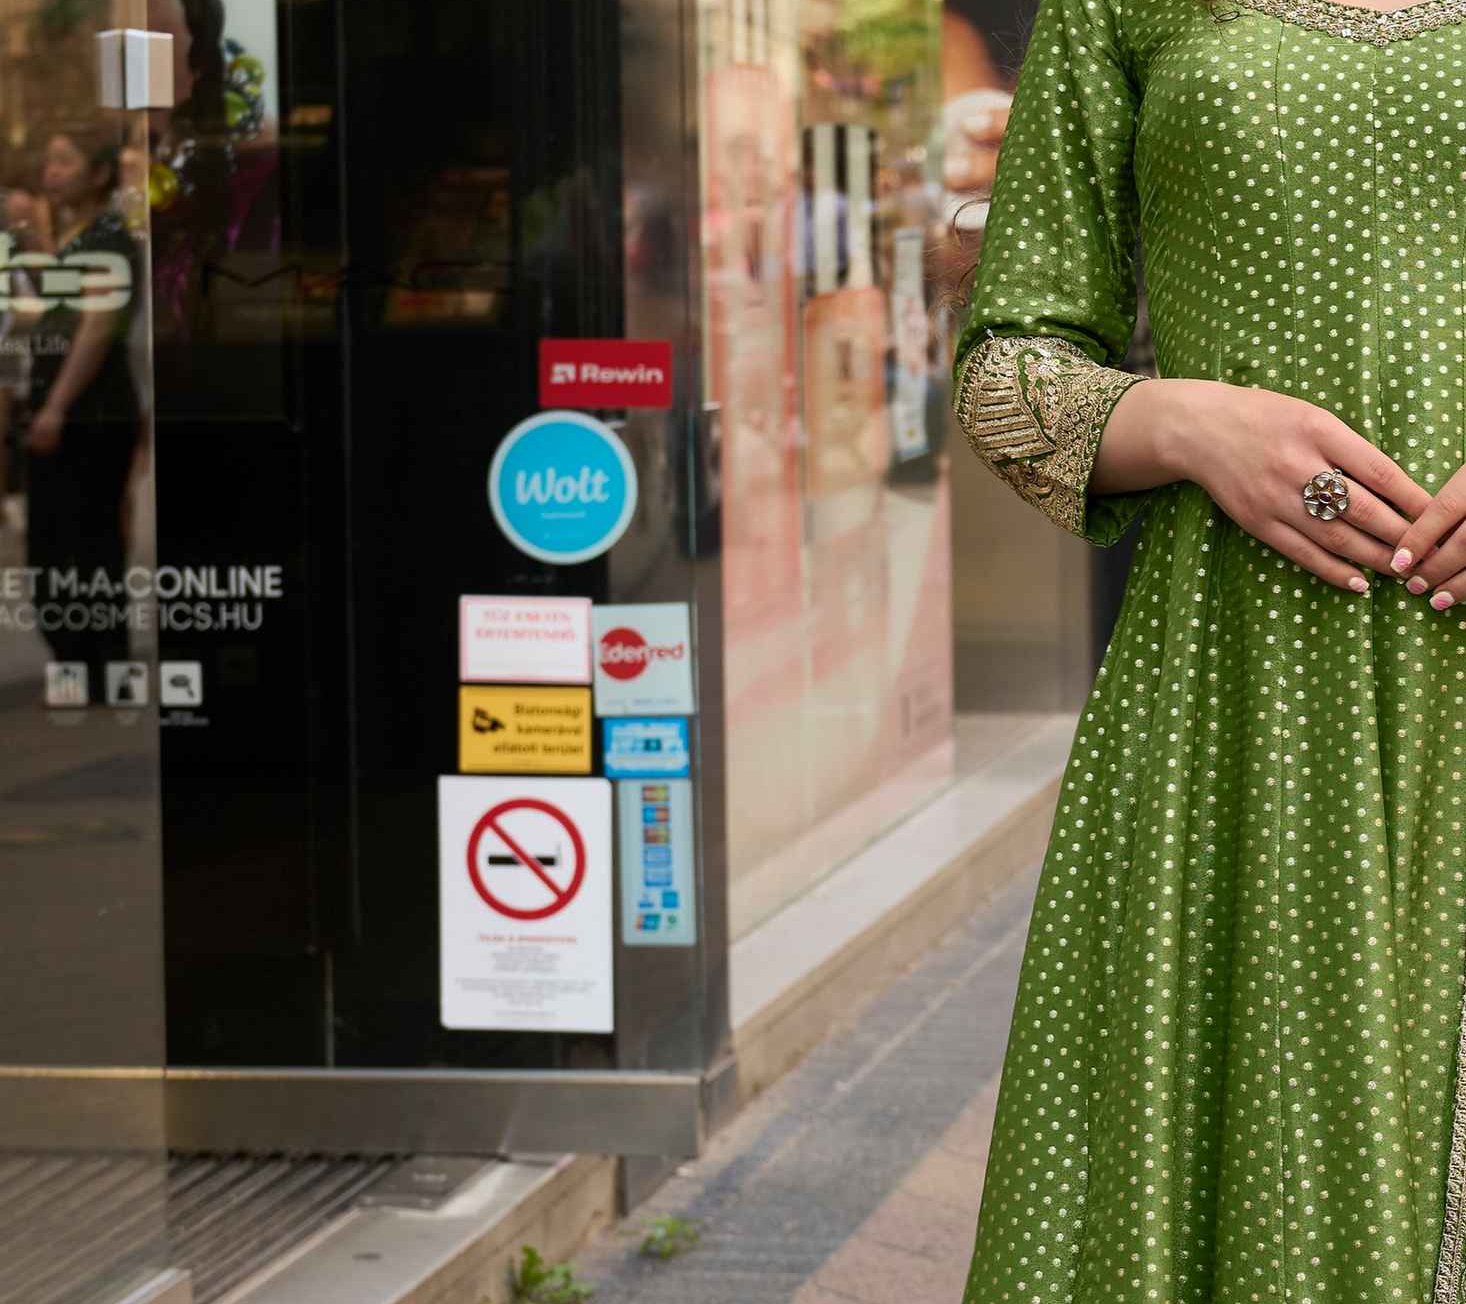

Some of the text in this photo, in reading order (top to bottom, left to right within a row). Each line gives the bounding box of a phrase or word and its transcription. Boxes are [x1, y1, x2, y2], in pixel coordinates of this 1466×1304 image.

[581, 362, 664, 384] Rewin
[515, 466, 610, 505] Wolt
[0, 566, 43, 598] ET
